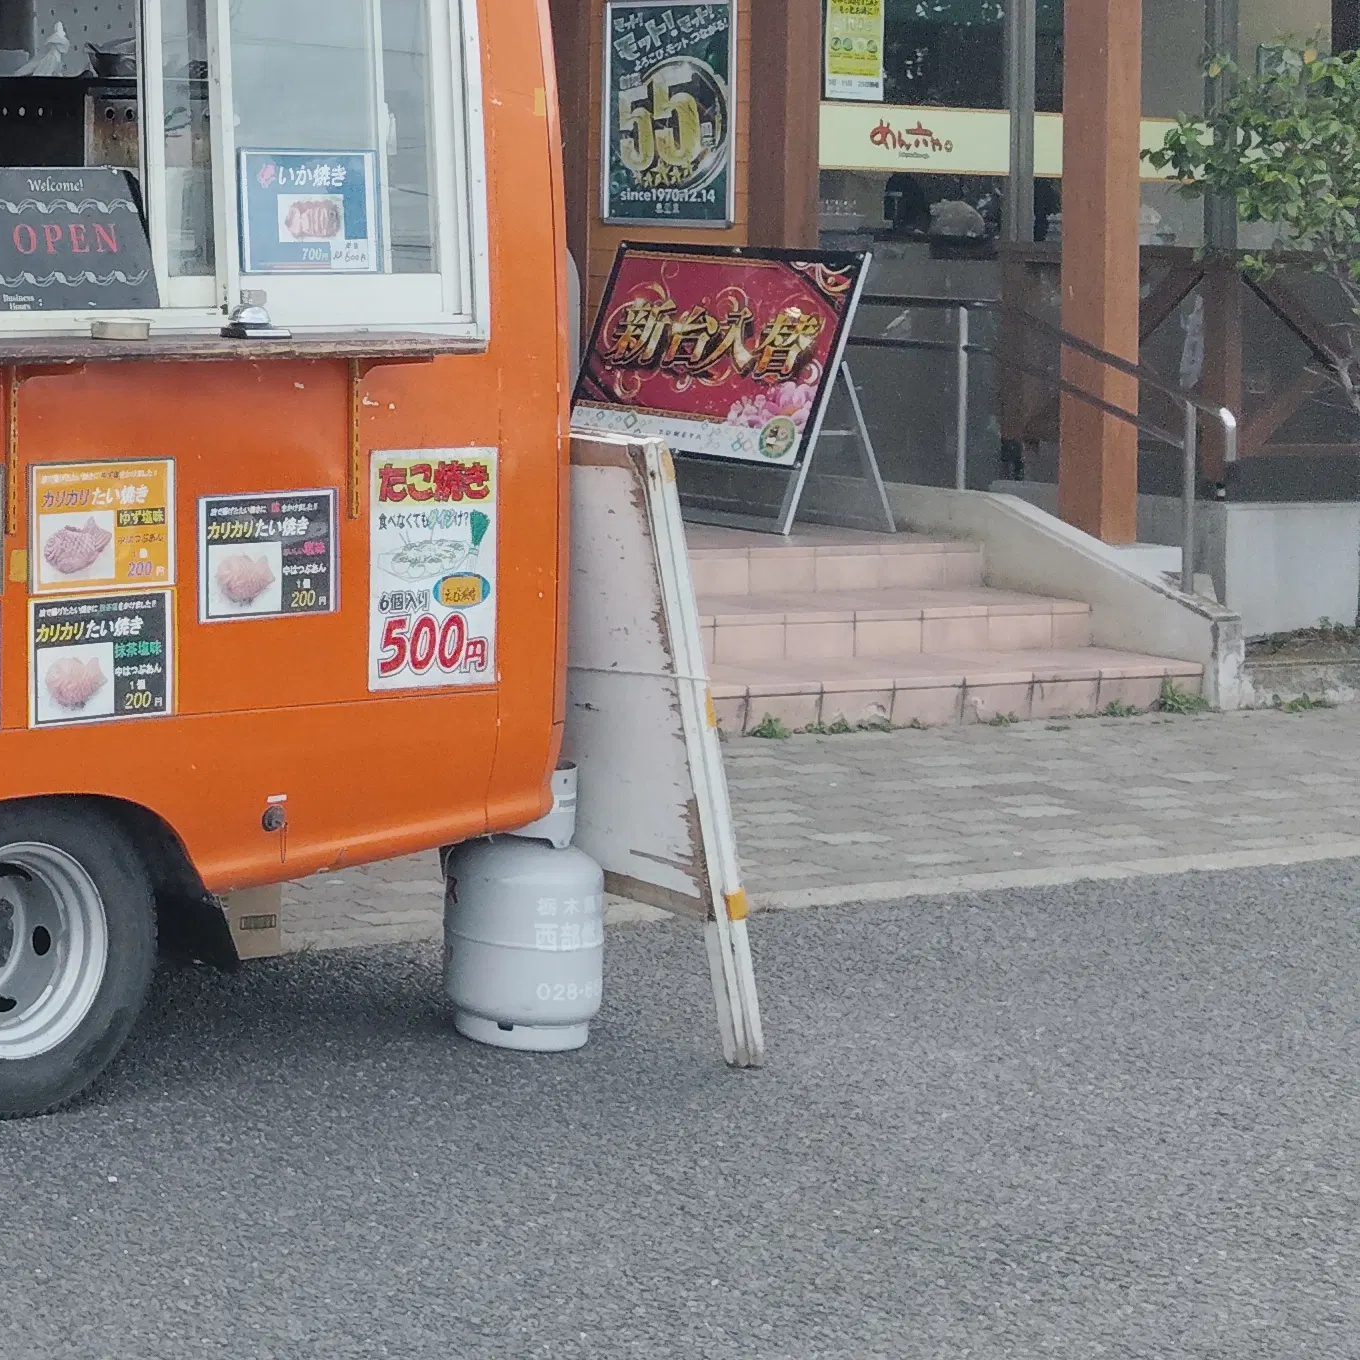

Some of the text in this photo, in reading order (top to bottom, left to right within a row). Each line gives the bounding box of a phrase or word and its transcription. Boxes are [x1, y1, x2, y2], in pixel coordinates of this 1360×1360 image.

[27, 176, 84, 192] Welcome!
[278, 164, 347, 187] いか焼き
[12, 223, 119, 255] OPEN
[606, 298, 816, 381] 新台入替
[378, 460, 490, 502] たこ焼き
[41, 483, 150, 508] カリカリたい焼き
[207, 515, 310, 540] カリカリたい焼き
[378, 588, 430, 614] 6個入り
[35, 615, 144, 643] カリカリたい焼き
[377, 610, 489, 679] 500円
